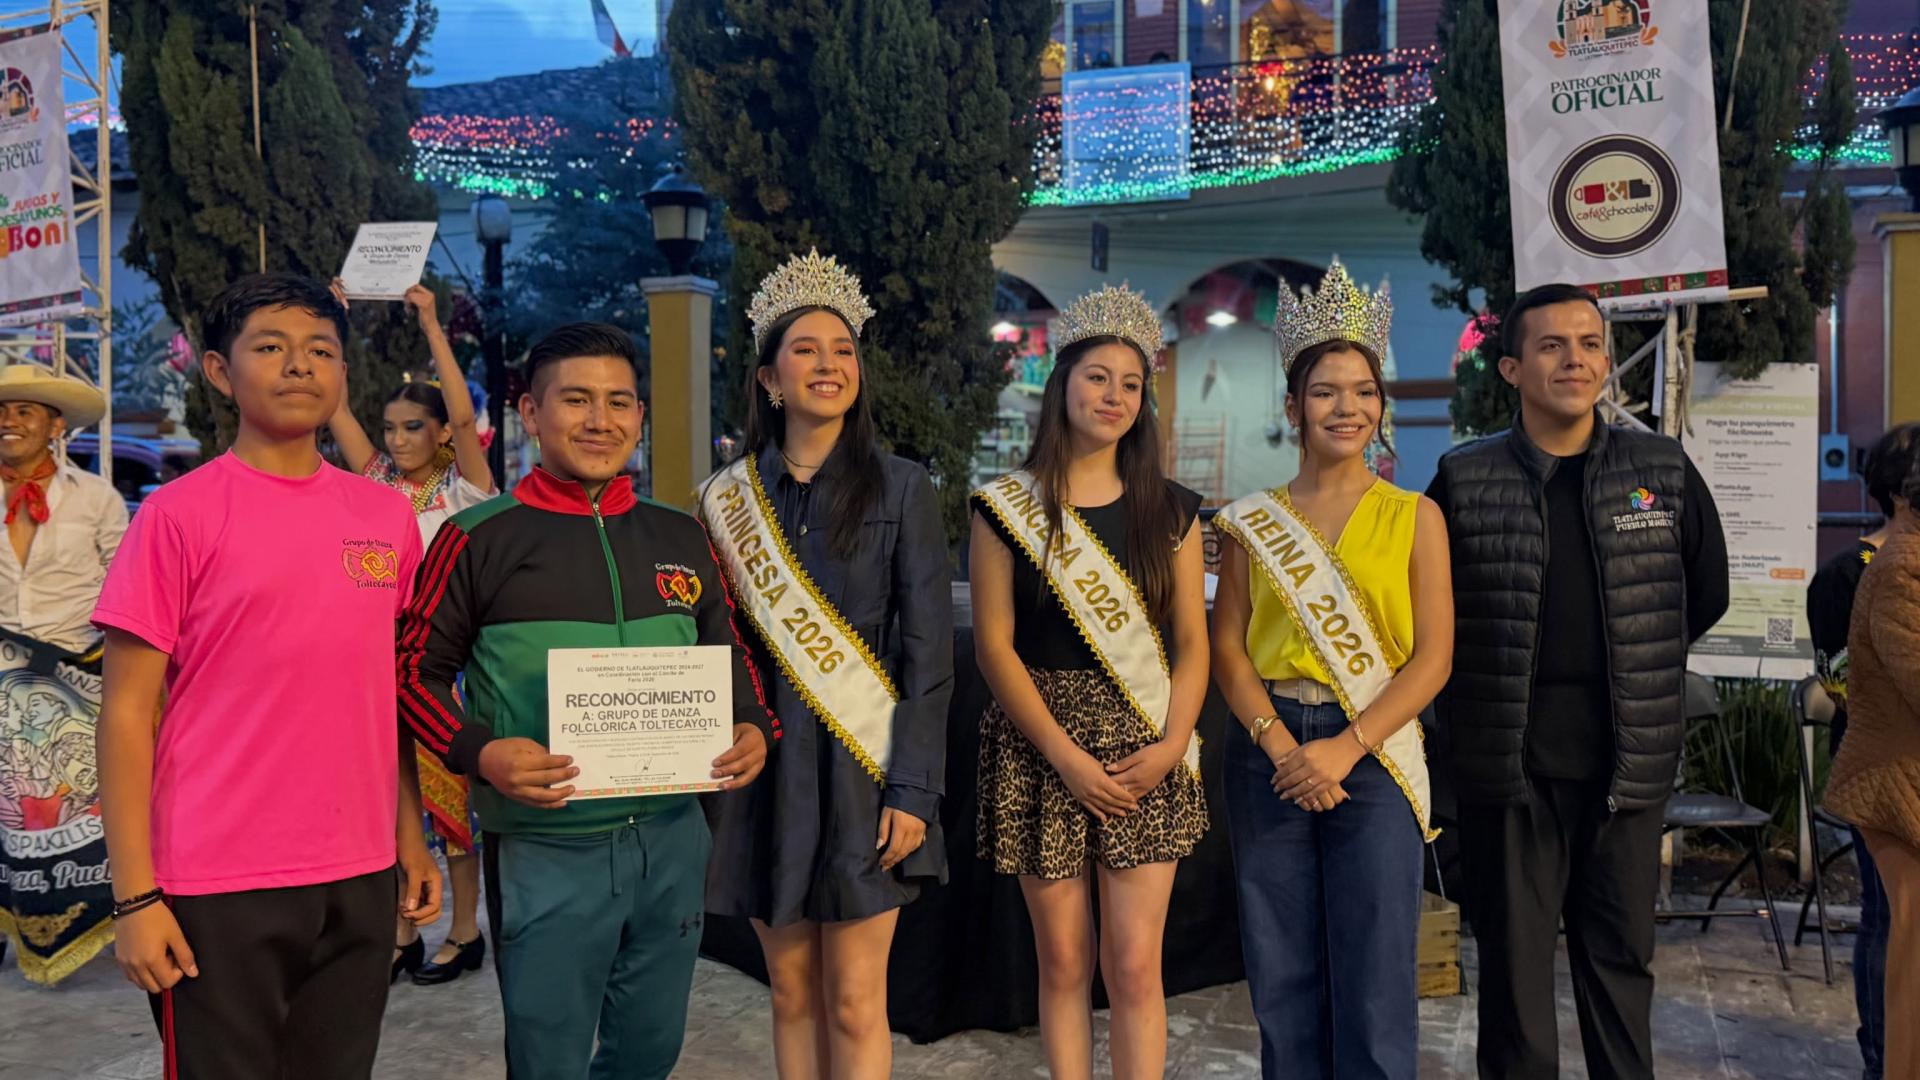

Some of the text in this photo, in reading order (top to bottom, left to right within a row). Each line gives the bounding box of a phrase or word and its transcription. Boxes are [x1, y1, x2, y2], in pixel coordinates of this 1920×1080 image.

[1550, 67, 1662, 94] PATROCINADOR
[1551, 80, 1664, 114] OFICIAL
[51, 191, 60, 204] Y
[342, 538, 365, 547] Grupo
[717, 483, 845, 675] PRINCESA 2026
[1073, 570, 1131, 632] 2026
[1240, 508, 1375, 676] REINA 2026
[565, 690, 716, 708] RECONOCIMIENTO
[582, 707, 701, 721] A: GRUPO DE DANZA
[640, 718, 721, 730] TOLTECAYOTL
